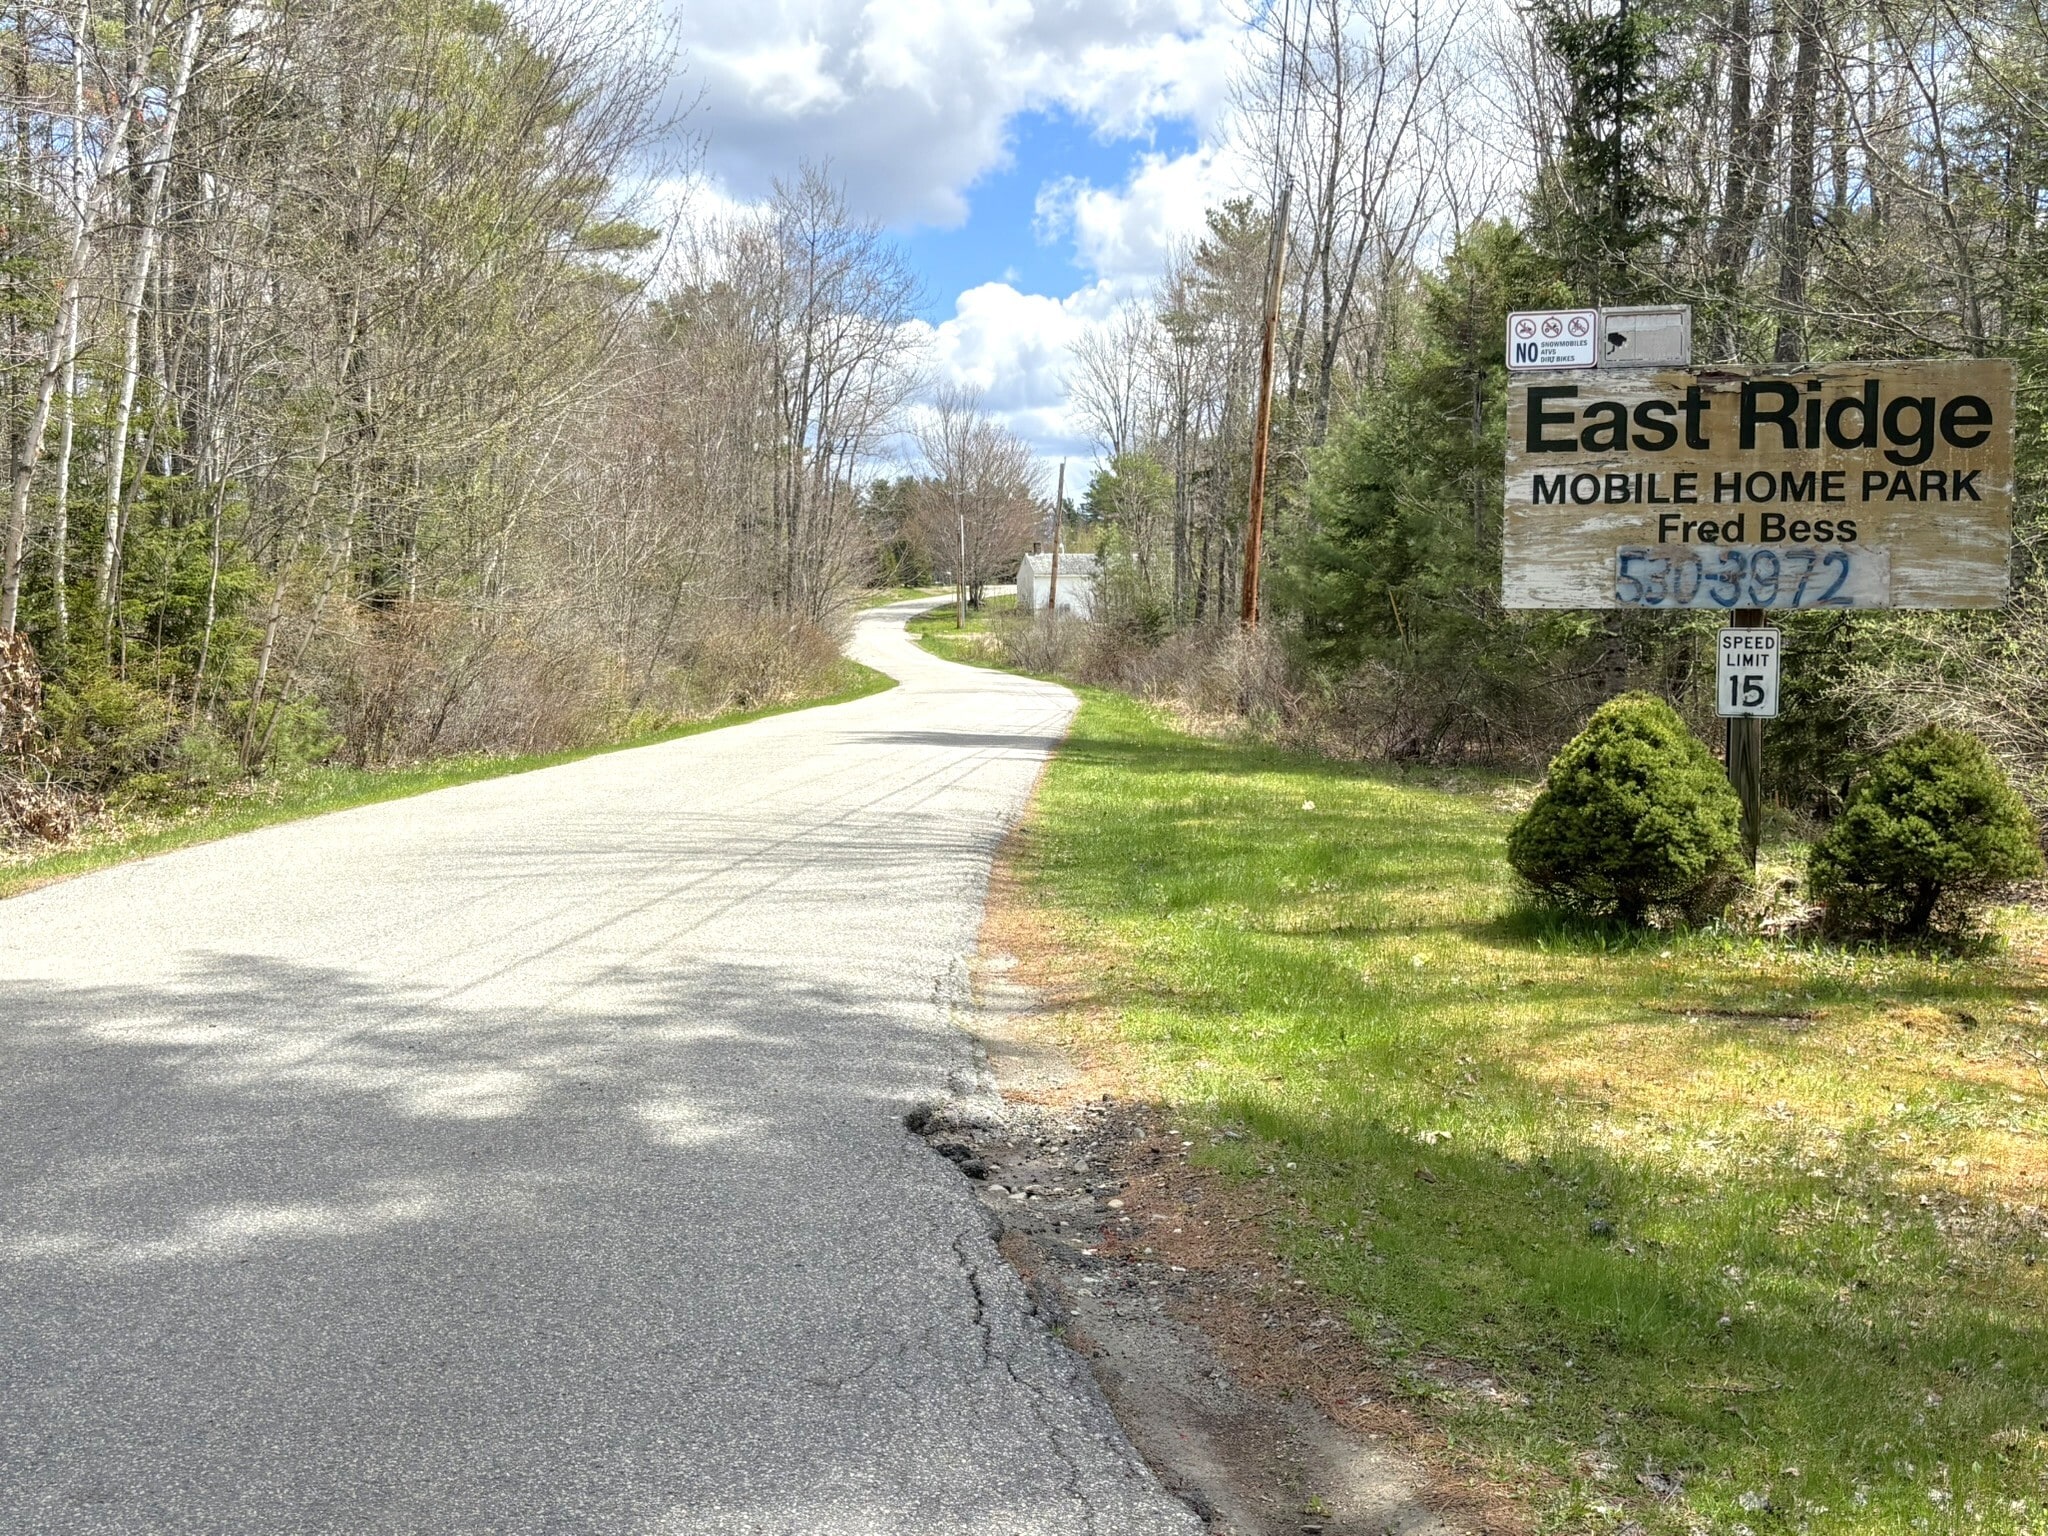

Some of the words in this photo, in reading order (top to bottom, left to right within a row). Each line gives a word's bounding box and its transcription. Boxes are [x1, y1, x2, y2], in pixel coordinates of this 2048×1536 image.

[1516, 342, 1538, 363] NO
[1540, 340, 1588, 348] SNOWMOBILES
[1526, 385, 1711, 453] East
[1739, 379, 1993, 466] Ridge
[1532, 473, 1698, 505] MOBILE
[1713, 471, 1846, 503] HOME
[1861, 469, 1983, 501] PARK
[1658, 513, 1745, 544] Fred
[1760, 514, 1858, 543] Bess
[1723, 636, 1775, 650] SPEED
[1726, 653, 1769, 667] LIMIT
[1729, 675, 1764, 707] 15
